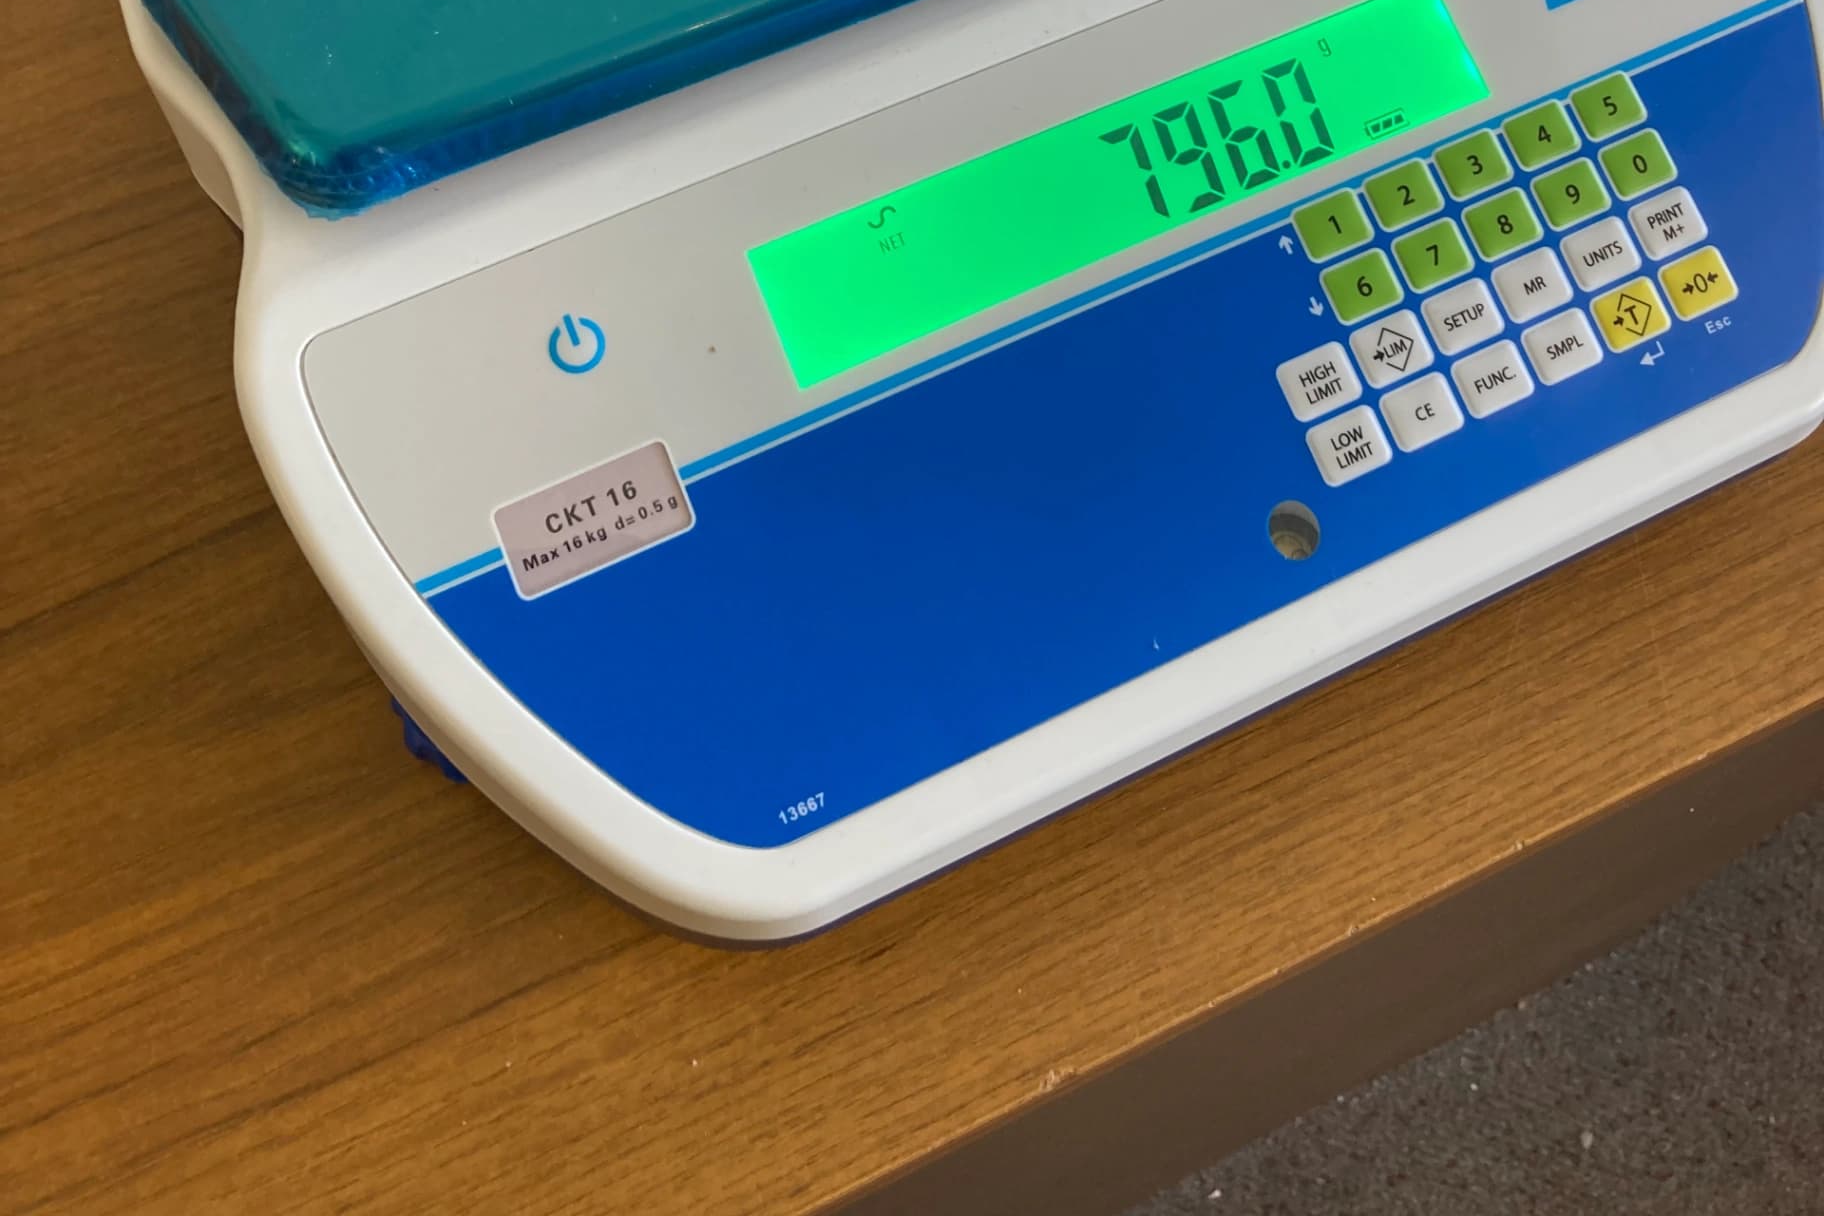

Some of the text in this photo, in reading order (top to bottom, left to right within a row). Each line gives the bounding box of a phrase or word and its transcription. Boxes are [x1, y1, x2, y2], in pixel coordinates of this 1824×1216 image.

[1318, 36, 1333, 58] g
[1603, 97, 1618, 116] 5
[1099, 58, 1334, 219] 796.0
[1537, 124, 1552, 145] 4
[1468, 155, 1484, 175] 3
[1632, 155, 1648, 174] 0
[1397, 185, 1416, 206] 2
[1565, 185, 1581, 204] 9
[1328, 215, 1342, 235] 1
[1497, 215, 1513, 234] 8
[1646, 202, 1684, 230] PRINT
[878, 231, 907, 255] NET
[1662, 223, 1686, 242] M+
[1426, 245, 1440, 266] 7
[1583, 241, 1623, 267] UNITS
[1357, 277, 1373, 297] 6
[1523, 276, 1547, 295] MR
[1443, 304, 1485, 332] SETUP
[1705, 315, 1732, 334] Esc
[1383, 340, 1408, 358] LIM
[1546, 336, 1584, 360] SMPL
[1299, 361, 1336, 388] HIGH
[1474, 366, 1517, 394] FUNC.
[1305, 378, 1343, 405] LIMIT
[1415, 403, 1435, 421] CE
[1330, 426, 1365, 451] LOW
[1336, 442, 1373, 469] LIMIT
[545, 480, 637, 534] CKT 16
[522, 547, 560, 572] Max
[563, 535, 583, 553] 16
[585, 527, 607, 544] kg
[638, 499, 663, 520] 0.5
[668, 495, 678, 509] g
[778, 792, 825, 824] 13667
